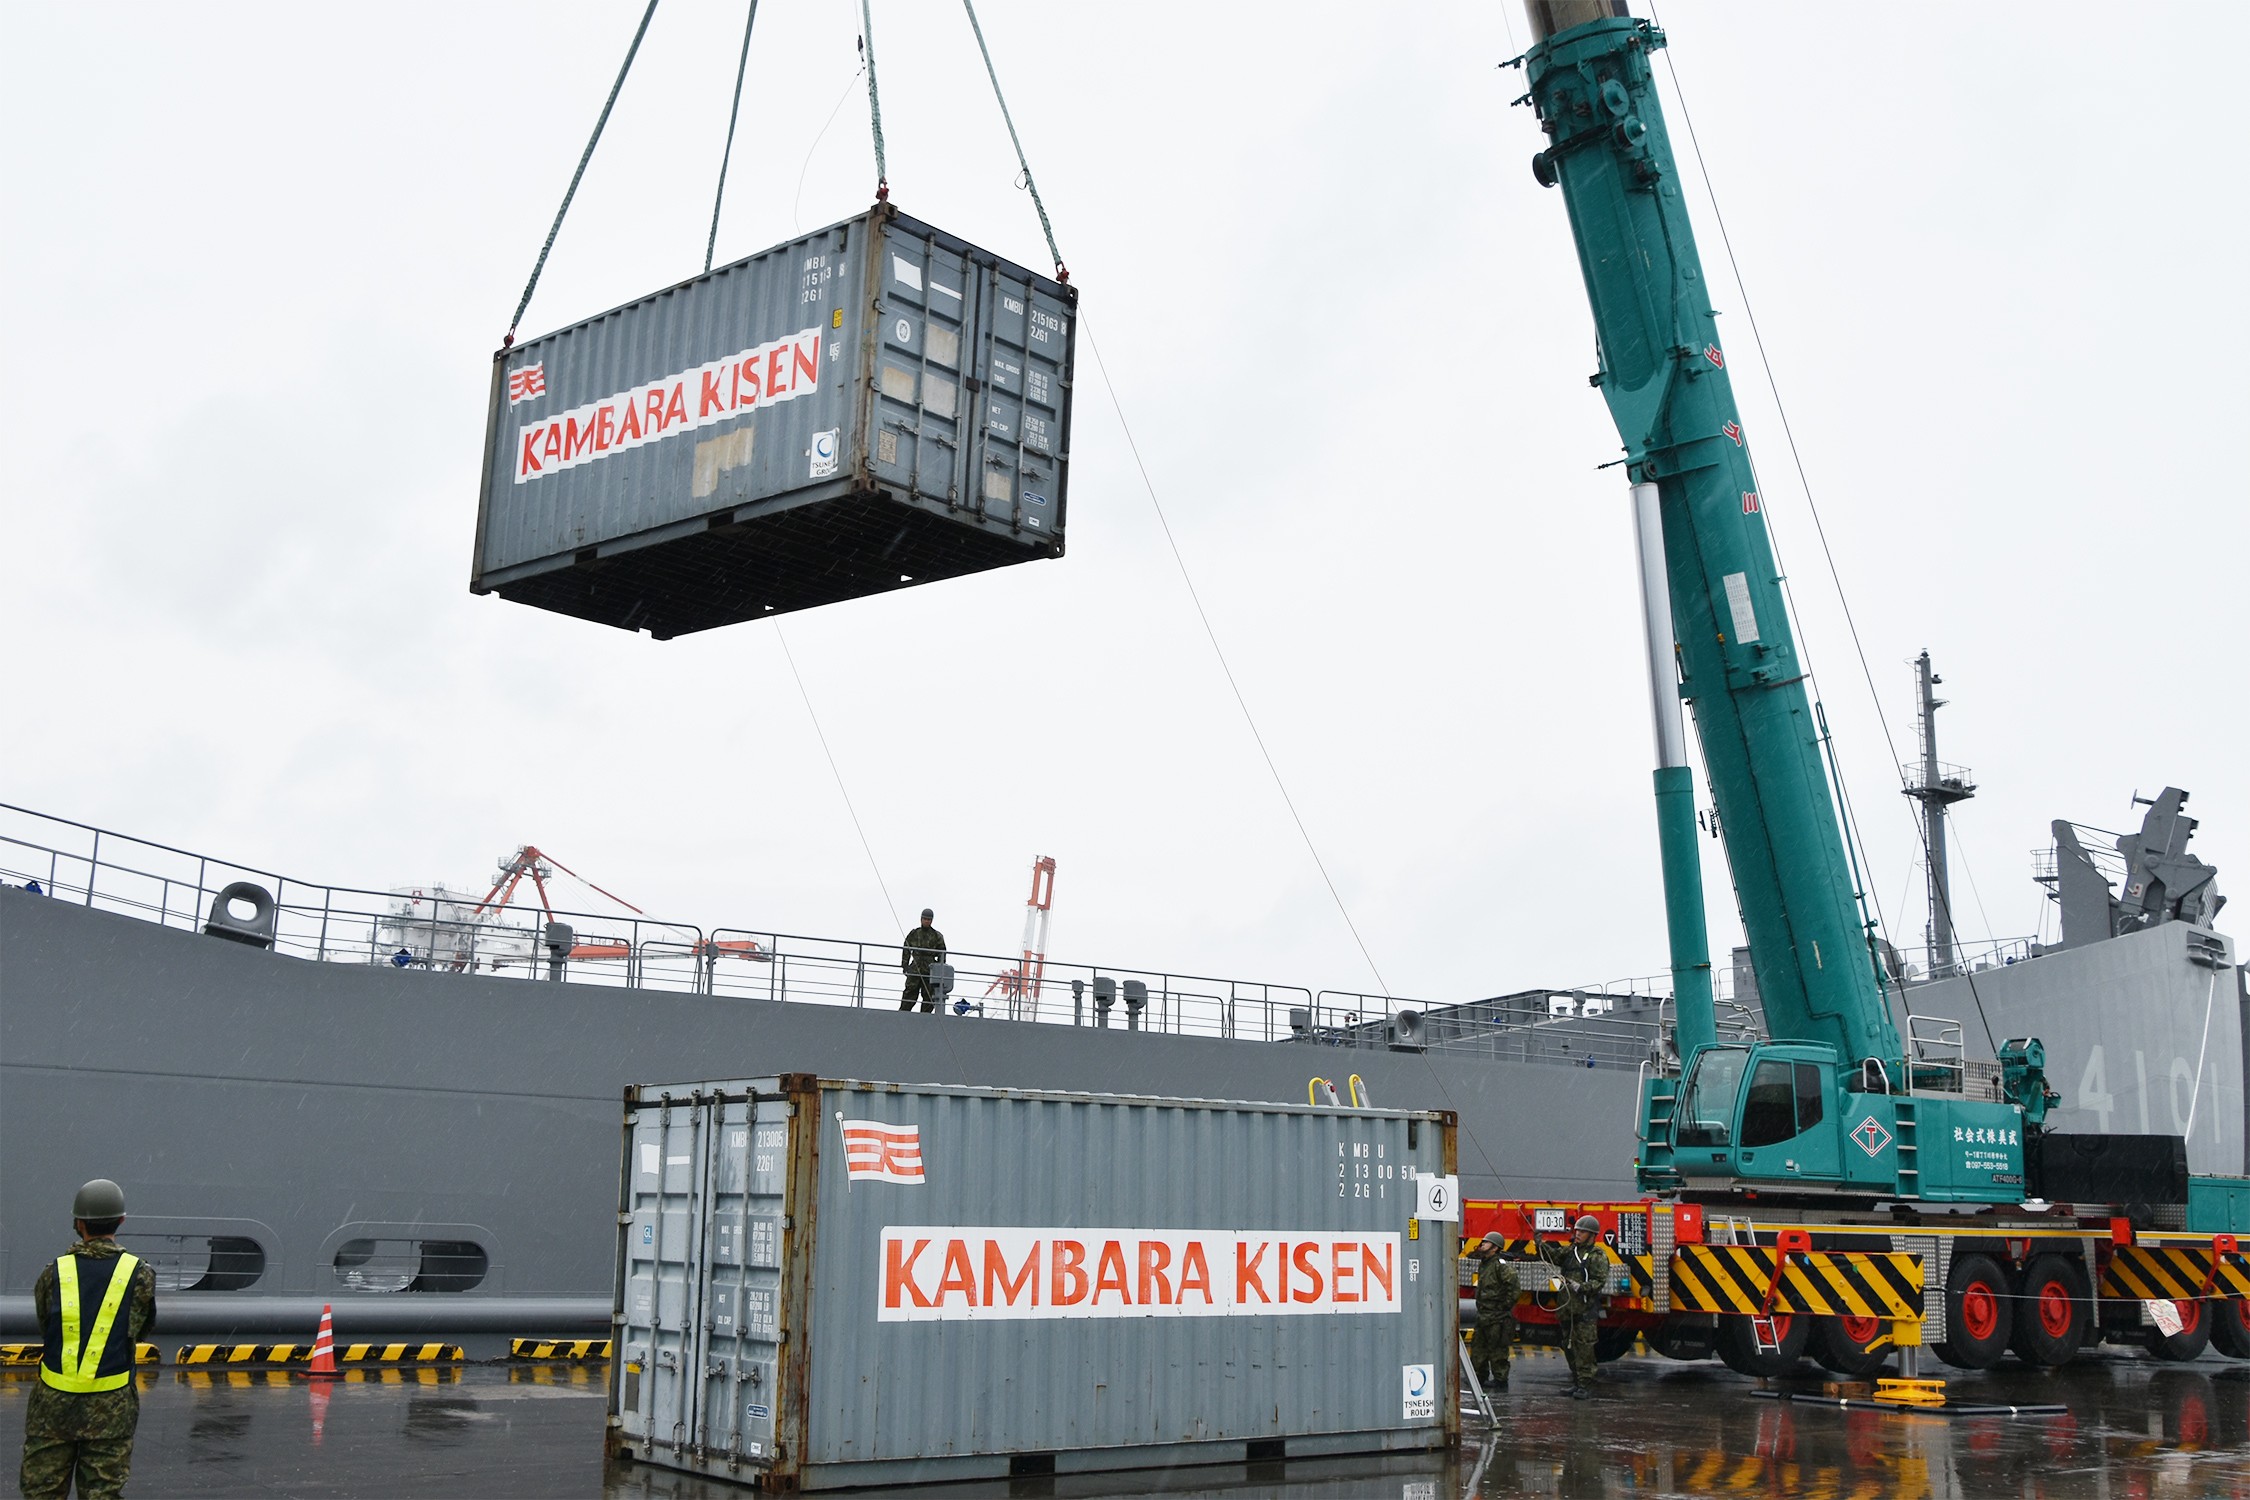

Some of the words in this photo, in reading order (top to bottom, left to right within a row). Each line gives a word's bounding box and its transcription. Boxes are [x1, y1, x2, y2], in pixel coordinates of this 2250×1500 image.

[804, 255, 826, 273] MBU
[1003, 296, 1024, 316] KMBU
[1031, 310, 1058, 332] 215163
[521, 382, 689, 476] KAMBARA
[699, 335, 819, 417] KISEN
[757, 1130, 784, 1148] 213005
[756, 1154, 774, 1172] 22G1
[884, 1239, 1214, 1308] KAMBARA
[1235, 1241, 1393, 1304] KISEN
